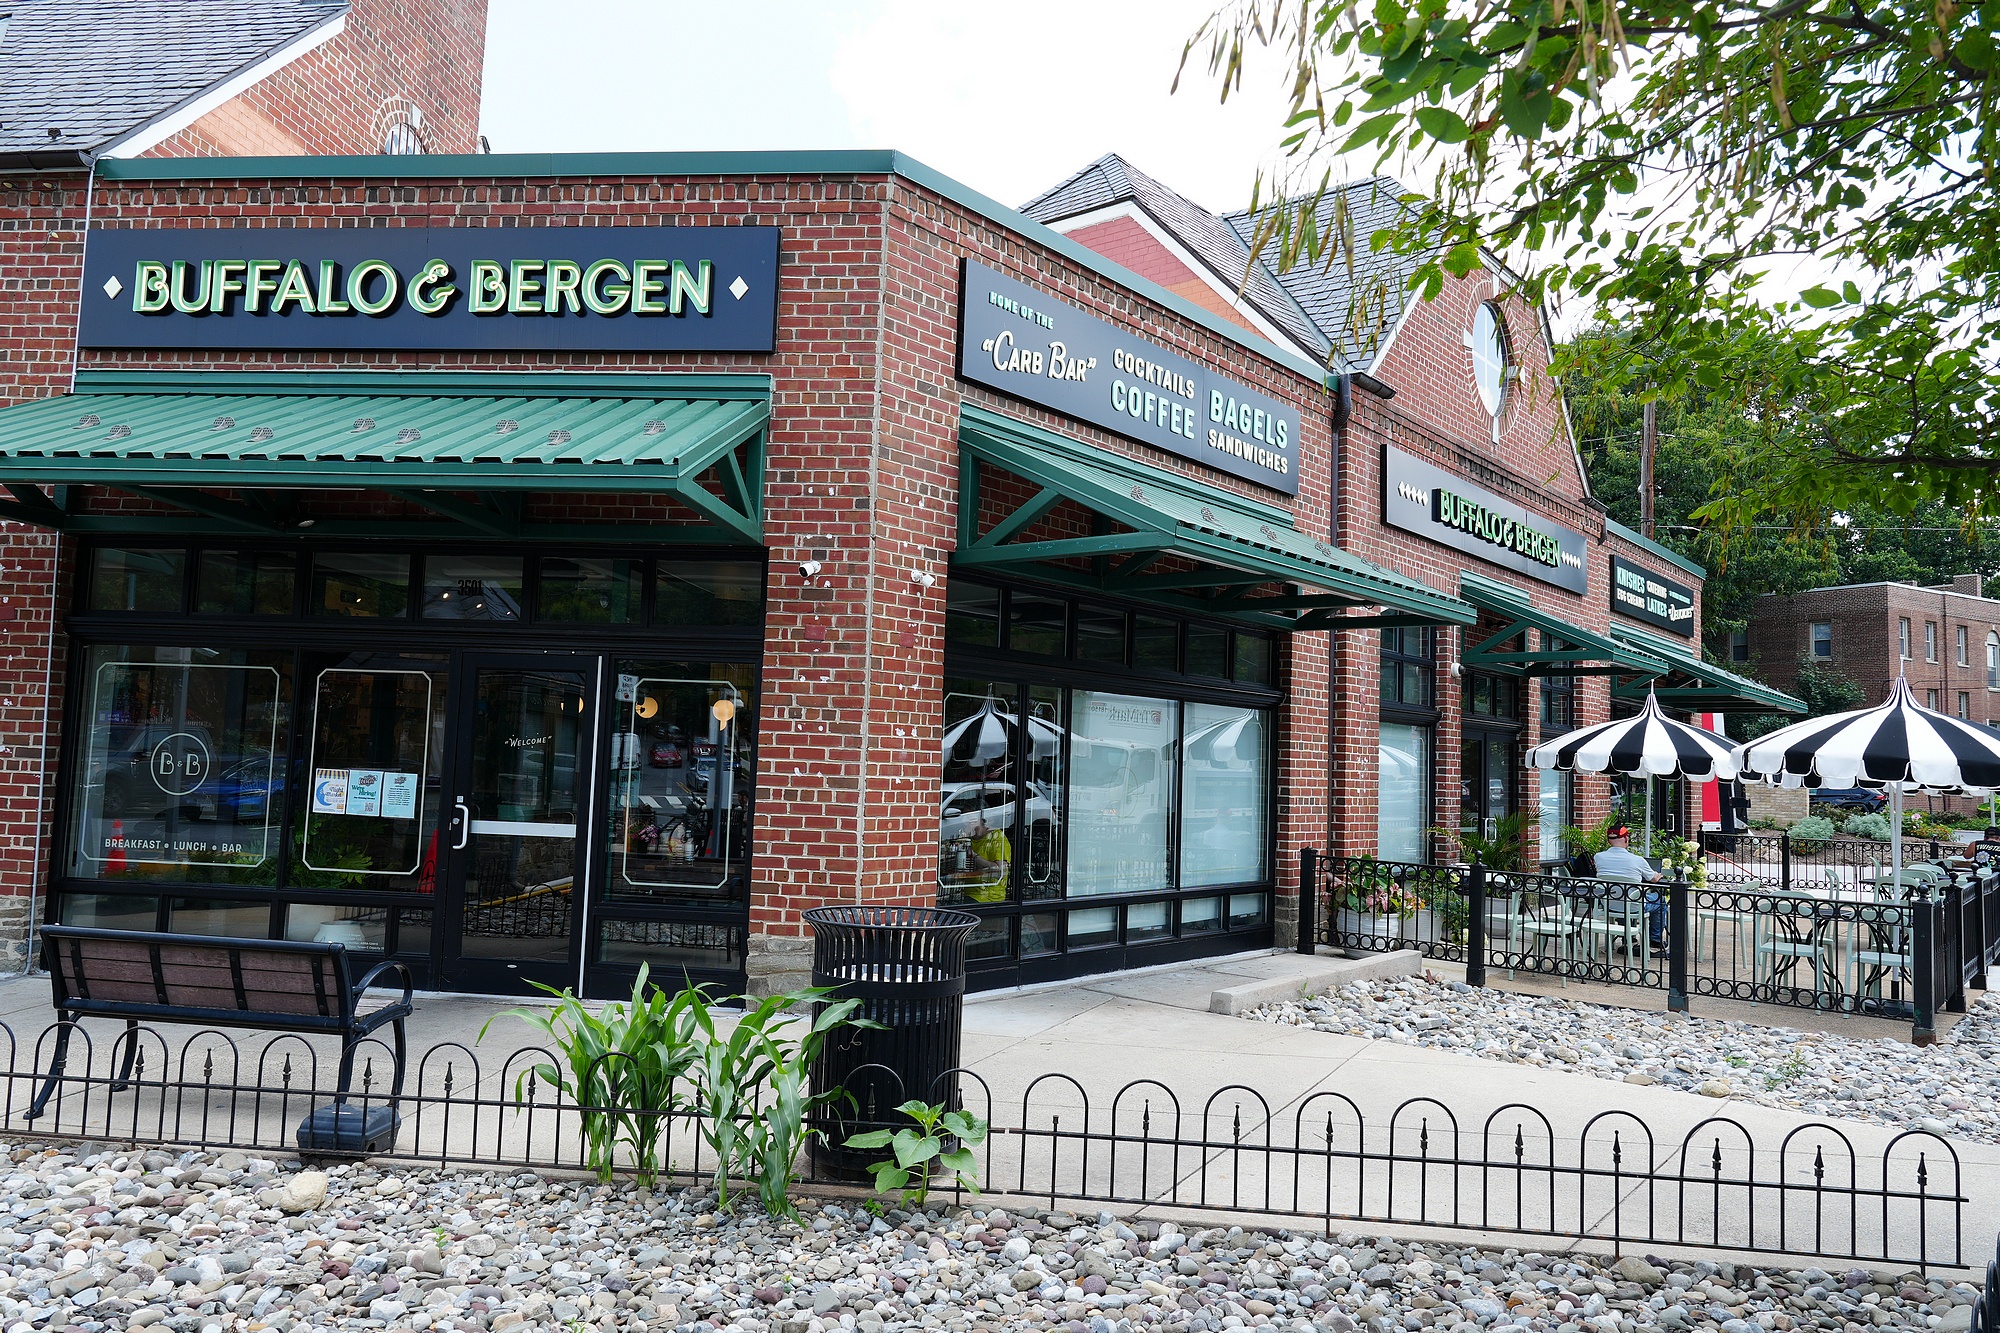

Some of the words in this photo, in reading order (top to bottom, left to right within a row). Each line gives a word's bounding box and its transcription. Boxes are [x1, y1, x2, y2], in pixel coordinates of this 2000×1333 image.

[132, 260, 399, 315] BUFFALO
[408, 258, 457, 316] &
[468, 259, 713, 315] BERGEN
[989, 291, 1019, 315] HOME
[1020, 304, 1034, 321] OF
[1034, 310, 1055, 330] THE
[1113, 347, 1196, 400] COCKTAILS
[1111, 379, 1196, 441] COFFEE
[1209, 389, 1289, 449] BAGELS
[1208, 428, 1289, 475] SANDWICHES
[1436, 487, 1503, 545] BUFFALO
[1503, 516, 1514, 548] &
[1515, 521, 1561, 568] BERGEN
[458, 579, 484, 596] 3501
[1616, 565, 1646, 595] KNISHES
[1646, 596, 1668, 618] LATKES
[159, 751, 175, 775] B
[185, 753, 201, 776] B
[104, 838, 161, 850] BREAKFAST
[173, 841, 207, 851] LUNCH
[221, 843, 242, 853] BAR
